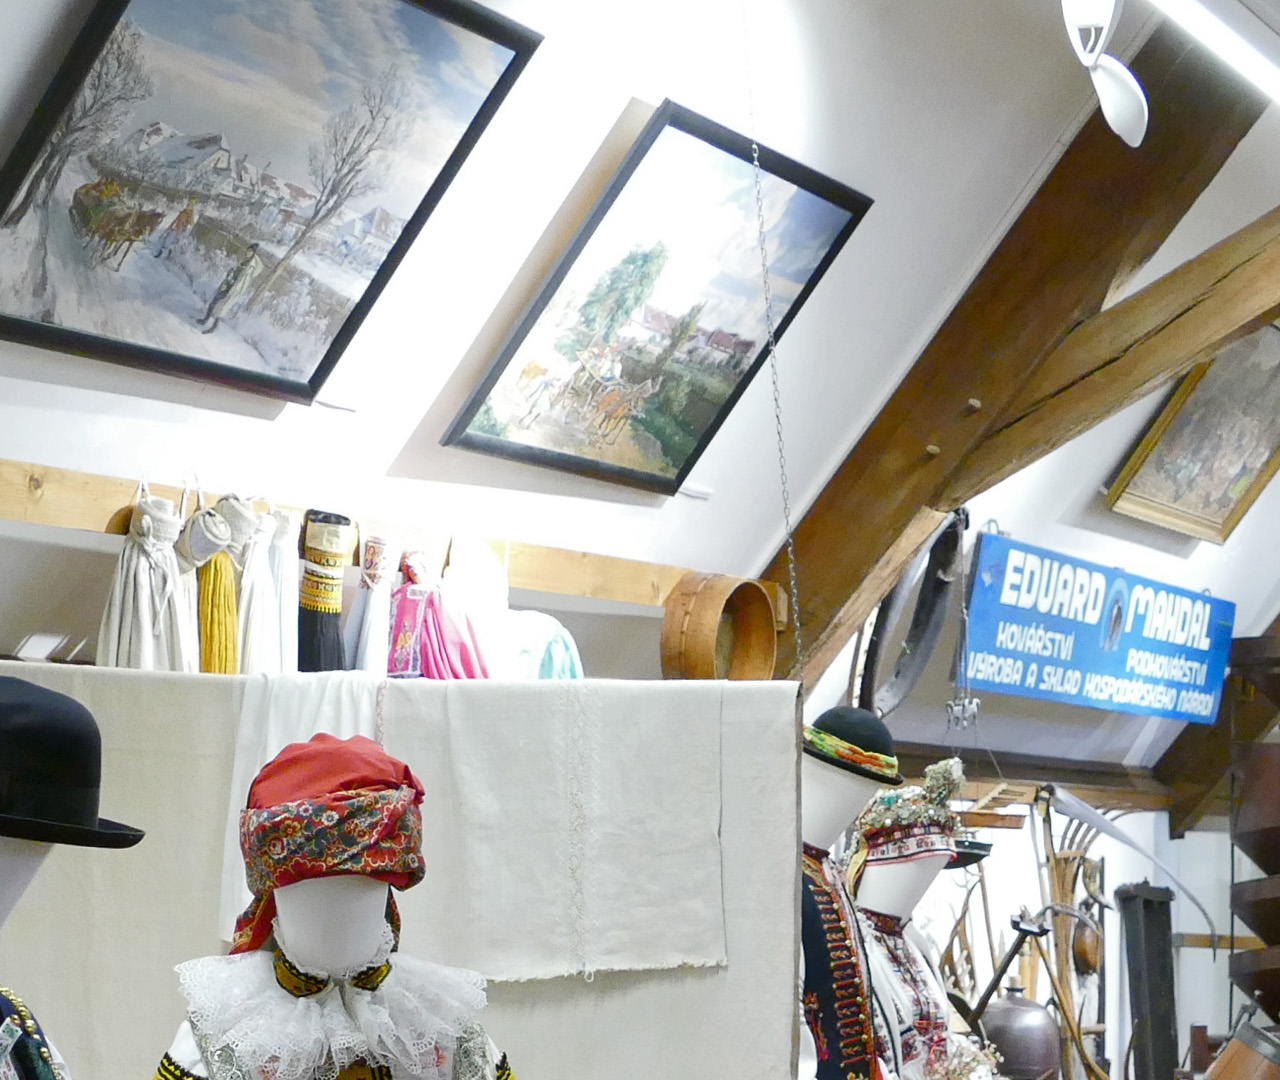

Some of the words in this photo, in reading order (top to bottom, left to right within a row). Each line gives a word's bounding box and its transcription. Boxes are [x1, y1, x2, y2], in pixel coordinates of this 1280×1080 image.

[1000, 548, 1107, 625] EDUARD
[1124, 584, 1211, 651] MAHDAL
[996, 620, 1075, 661] KOVÁŘSTVÍ
[966, 650, 1024, 686] VÝROBA
[1025, 662, 1038, 688] A
[1038, 664, 1082, 696] SKLAD
